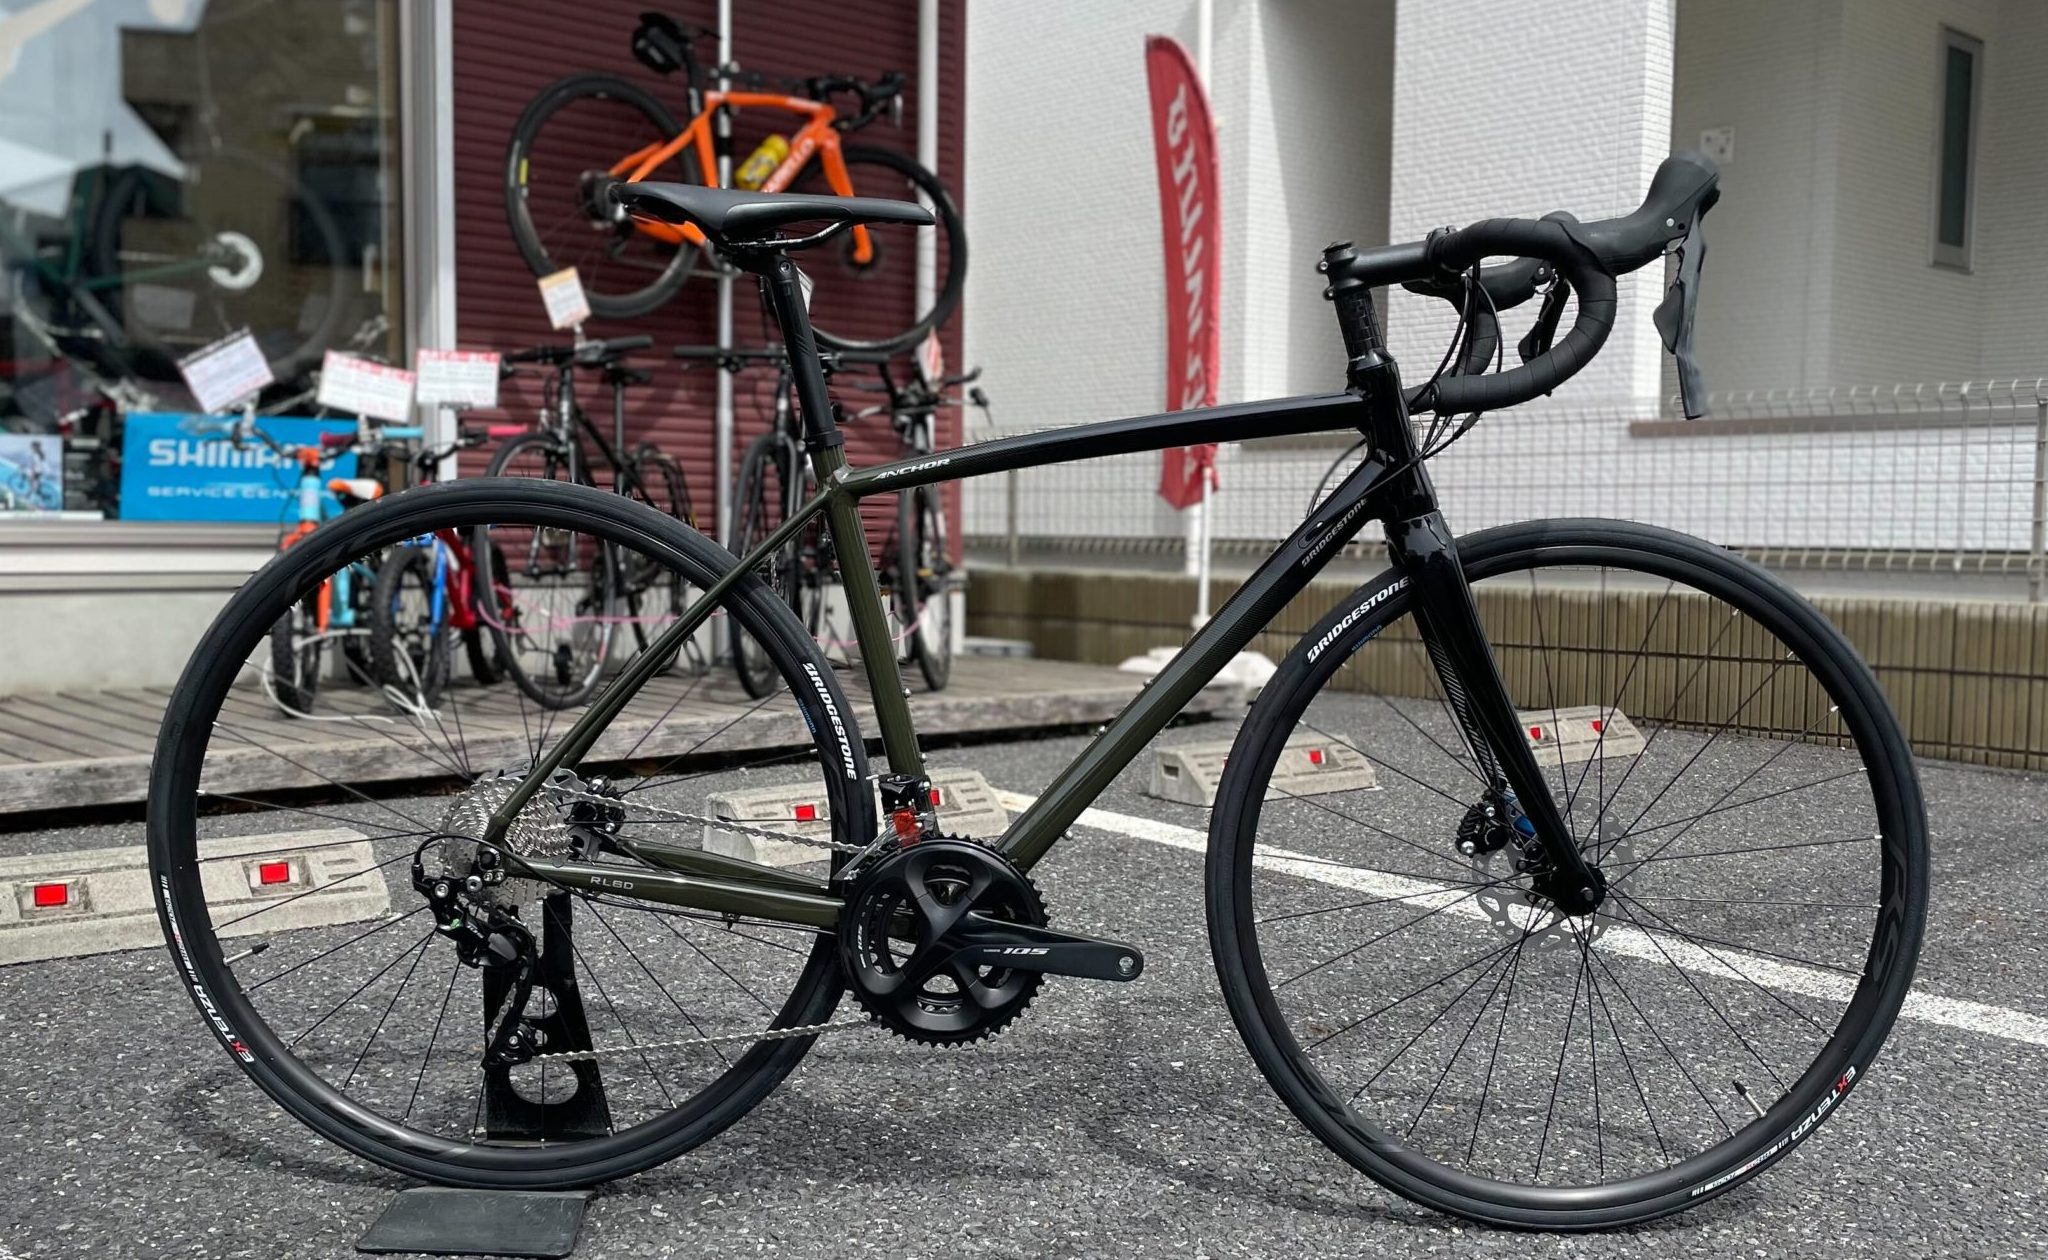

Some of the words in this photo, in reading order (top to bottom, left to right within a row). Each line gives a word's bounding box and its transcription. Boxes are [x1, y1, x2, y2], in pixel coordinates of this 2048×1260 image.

[148, 486, 238, 498] SERVICE
[872, 458, 950, 481] ANCHOR
[1302, 498, 1368, 567] BRIDGESTONE
[1307, 576, 1409, 664] BRIDGESTONE
[802, 662, 857, 780] BRIDGESTONE
[590, 876, 634, 890] RL6D
[193, 985, 255, 1063] EXTENZA
[1791, 1065, 1856, 1141] EXTENZA
